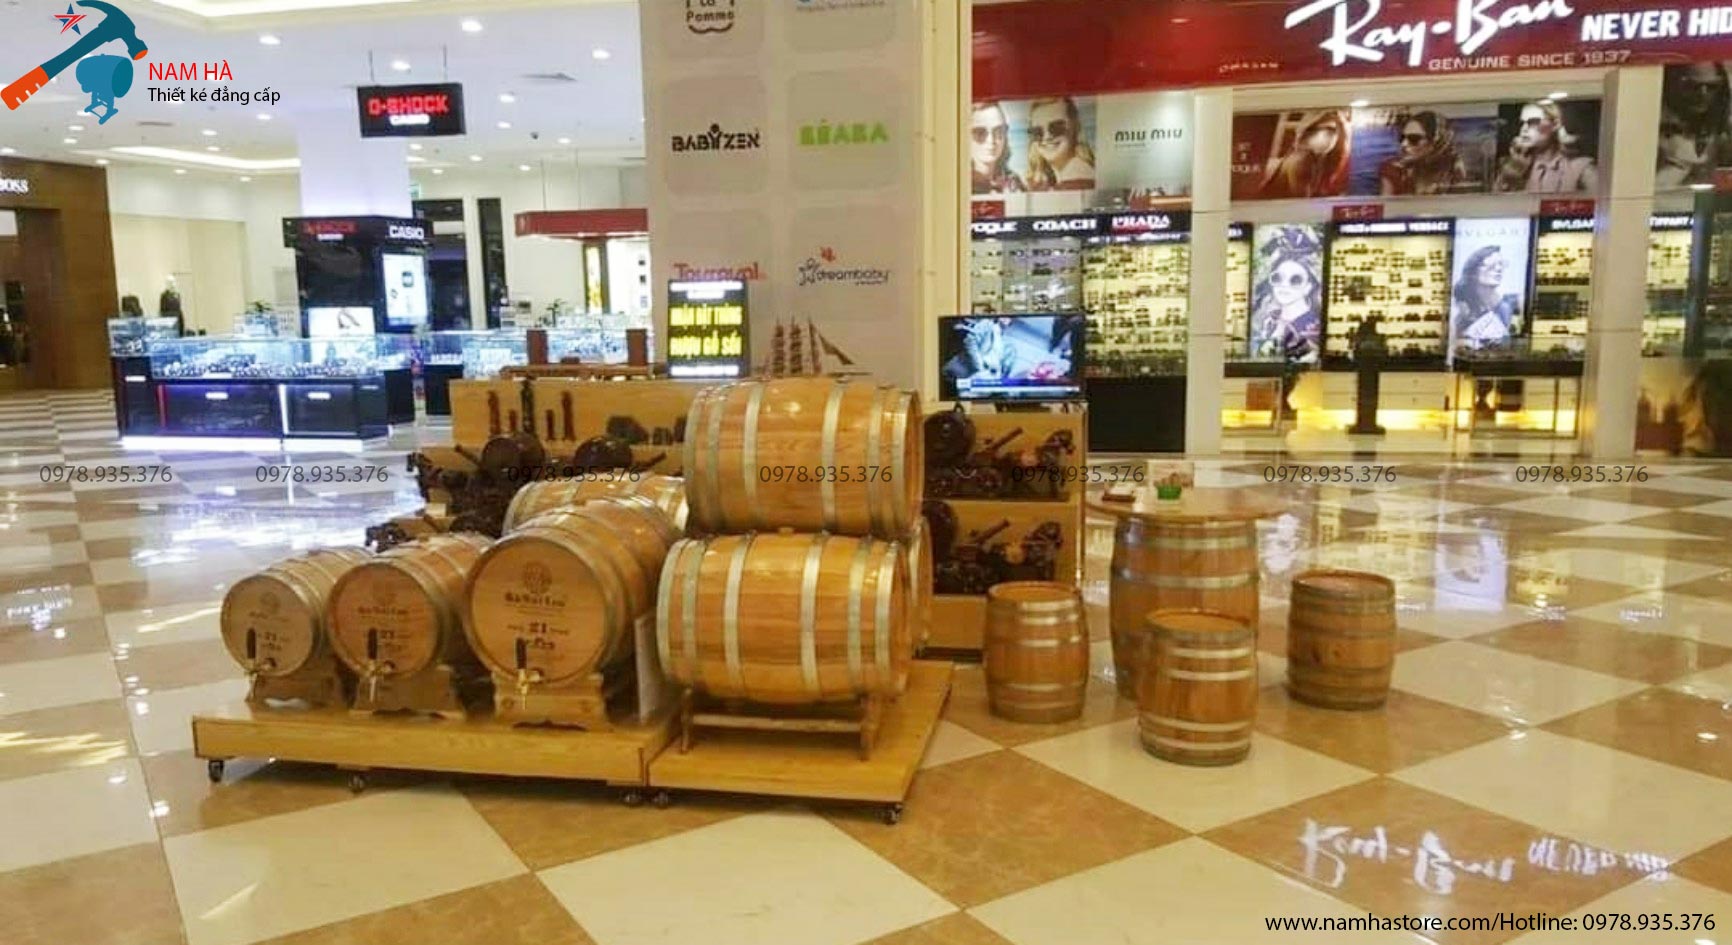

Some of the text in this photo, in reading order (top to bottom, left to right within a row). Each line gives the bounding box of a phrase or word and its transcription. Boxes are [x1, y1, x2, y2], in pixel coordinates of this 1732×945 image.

[686, 10, 735, 23] Pomme
[1284, 0, 1574, 66] Ray-Ban
[1581, 10, 1680, 42] NEVER
[1428, 49, 1632, 71] GENUINE SINCE 1937
[672, 124, 760, 151] BABYZEN
[1115, 127, 1183, 143] miu miu
[1033, 218, 1097, 231] COACH
[1112, 215, 1171, 230] PRADA
[389, 225, 425, 240] CASIO
[815, 267, 890, 281] dreambaby
